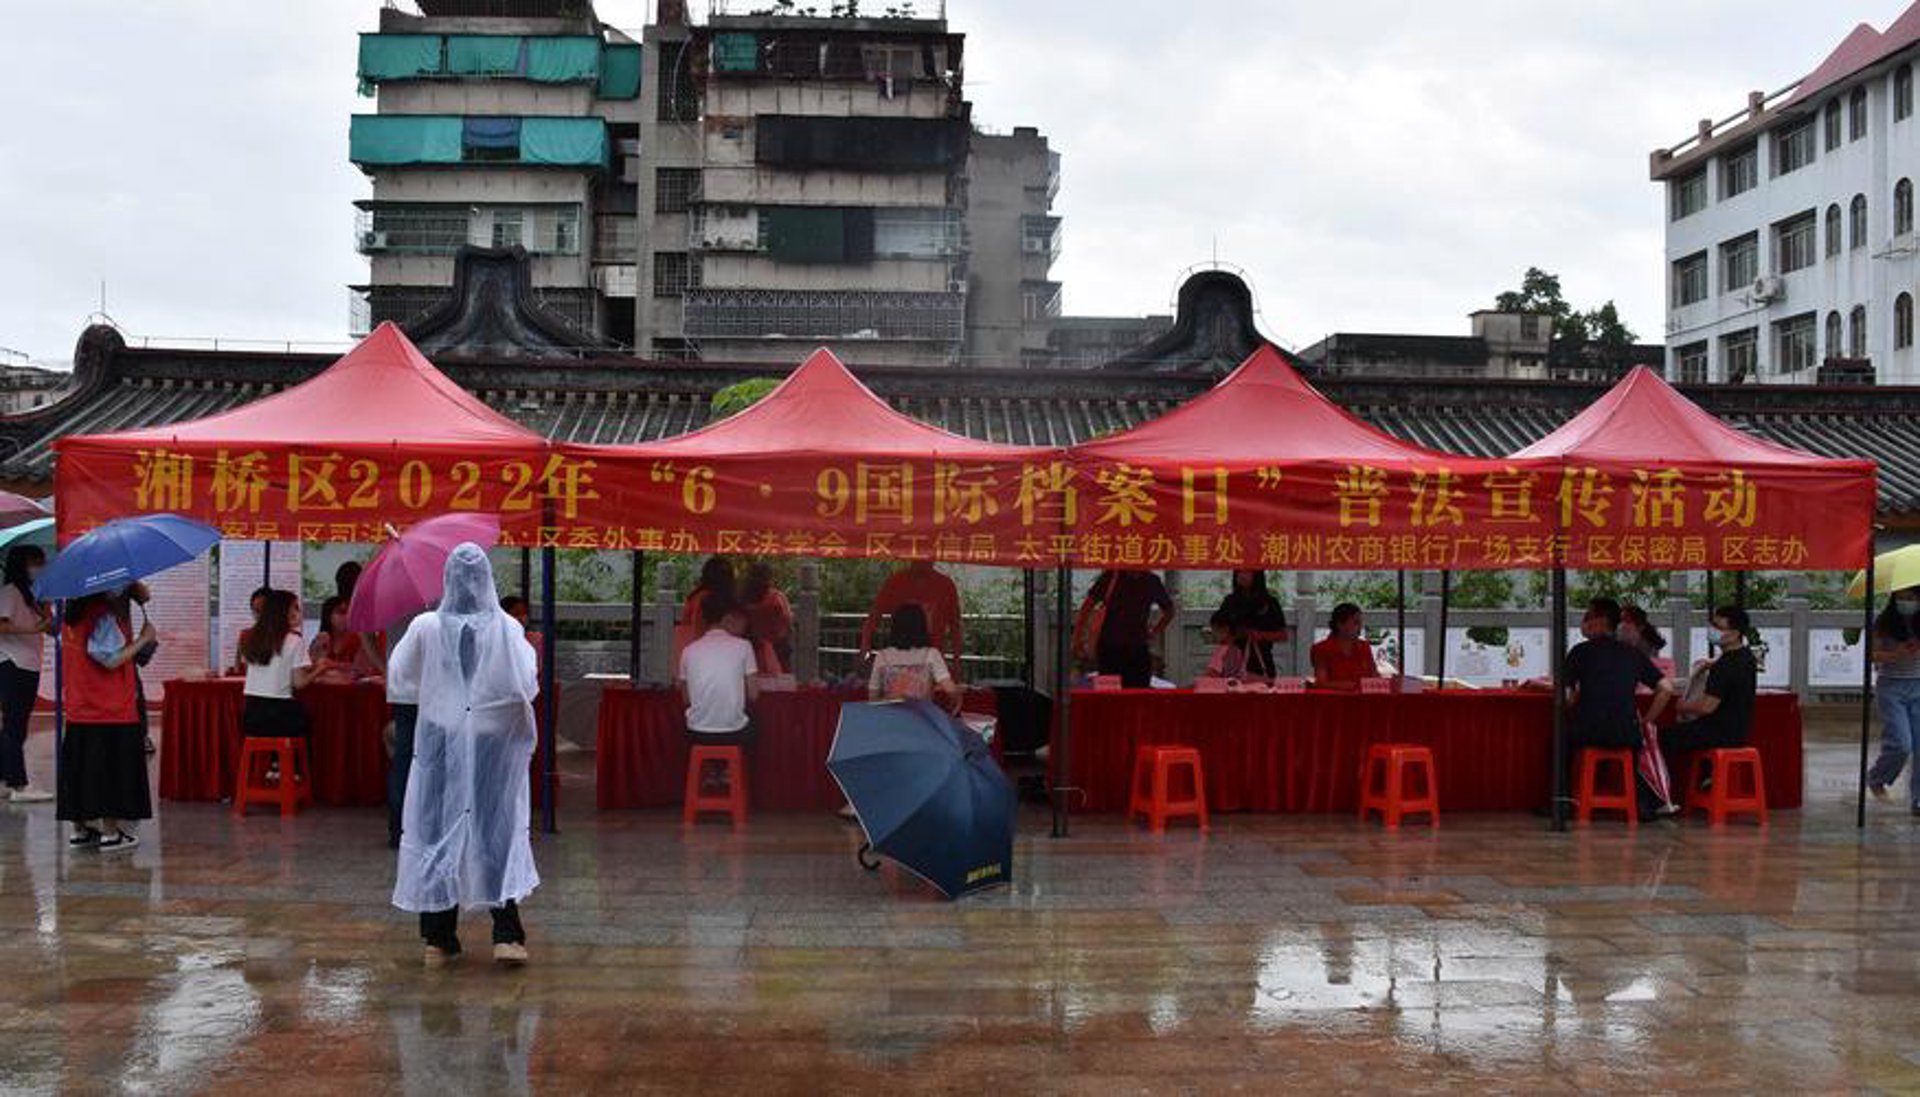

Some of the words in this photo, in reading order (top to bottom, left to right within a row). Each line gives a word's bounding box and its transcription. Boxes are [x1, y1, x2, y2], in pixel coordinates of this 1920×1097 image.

[133, 448, 600, 518] 湘桥区2022年
[297, 520, 411, 542] 区司法
[716, 529, 849, 556] 区法学会
[865, 532, 998, 560] 区工信局
[1015, 532, 1245, 565] 太平街道办事处
[1260, 532, 1573, 565] 潮州农商银行广场支行
[1587, 535, 1706, 565] 区保密局
[1722, 535, 1809, 565] 区志办
